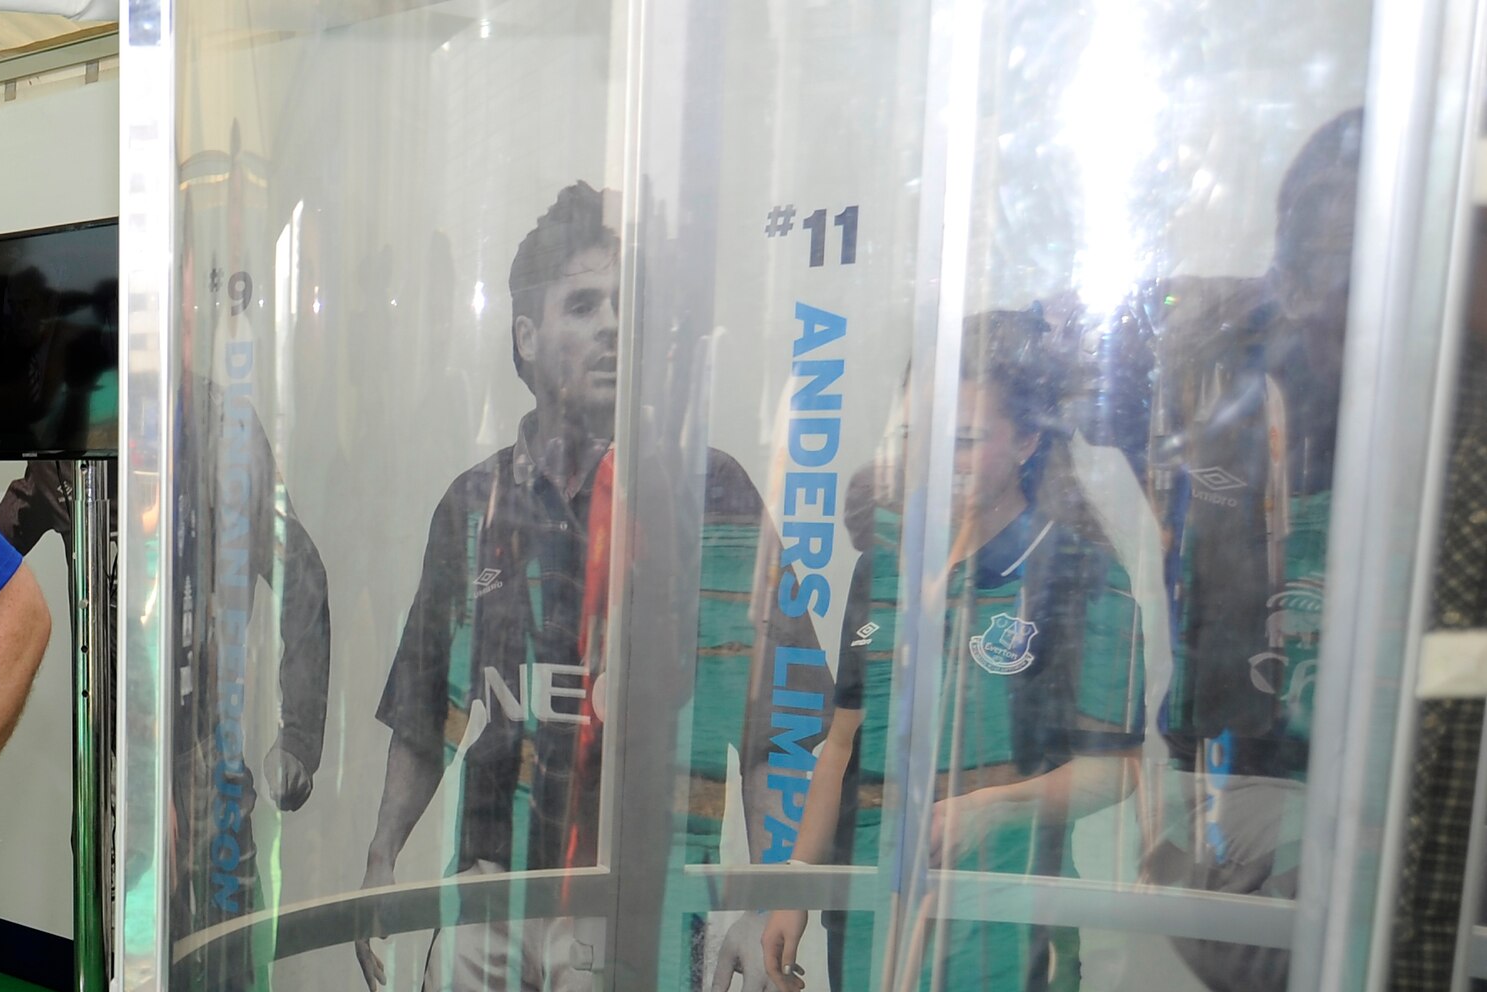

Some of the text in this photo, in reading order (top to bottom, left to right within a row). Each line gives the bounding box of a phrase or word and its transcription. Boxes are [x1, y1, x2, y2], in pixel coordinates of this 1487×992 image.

[209, 268, 253, 317] #9
[765, 204, 859, 267] #11
[220, 341, 253, 589] DUNCAN
[762, 301, 847, 865] ANDERS LIMPA
